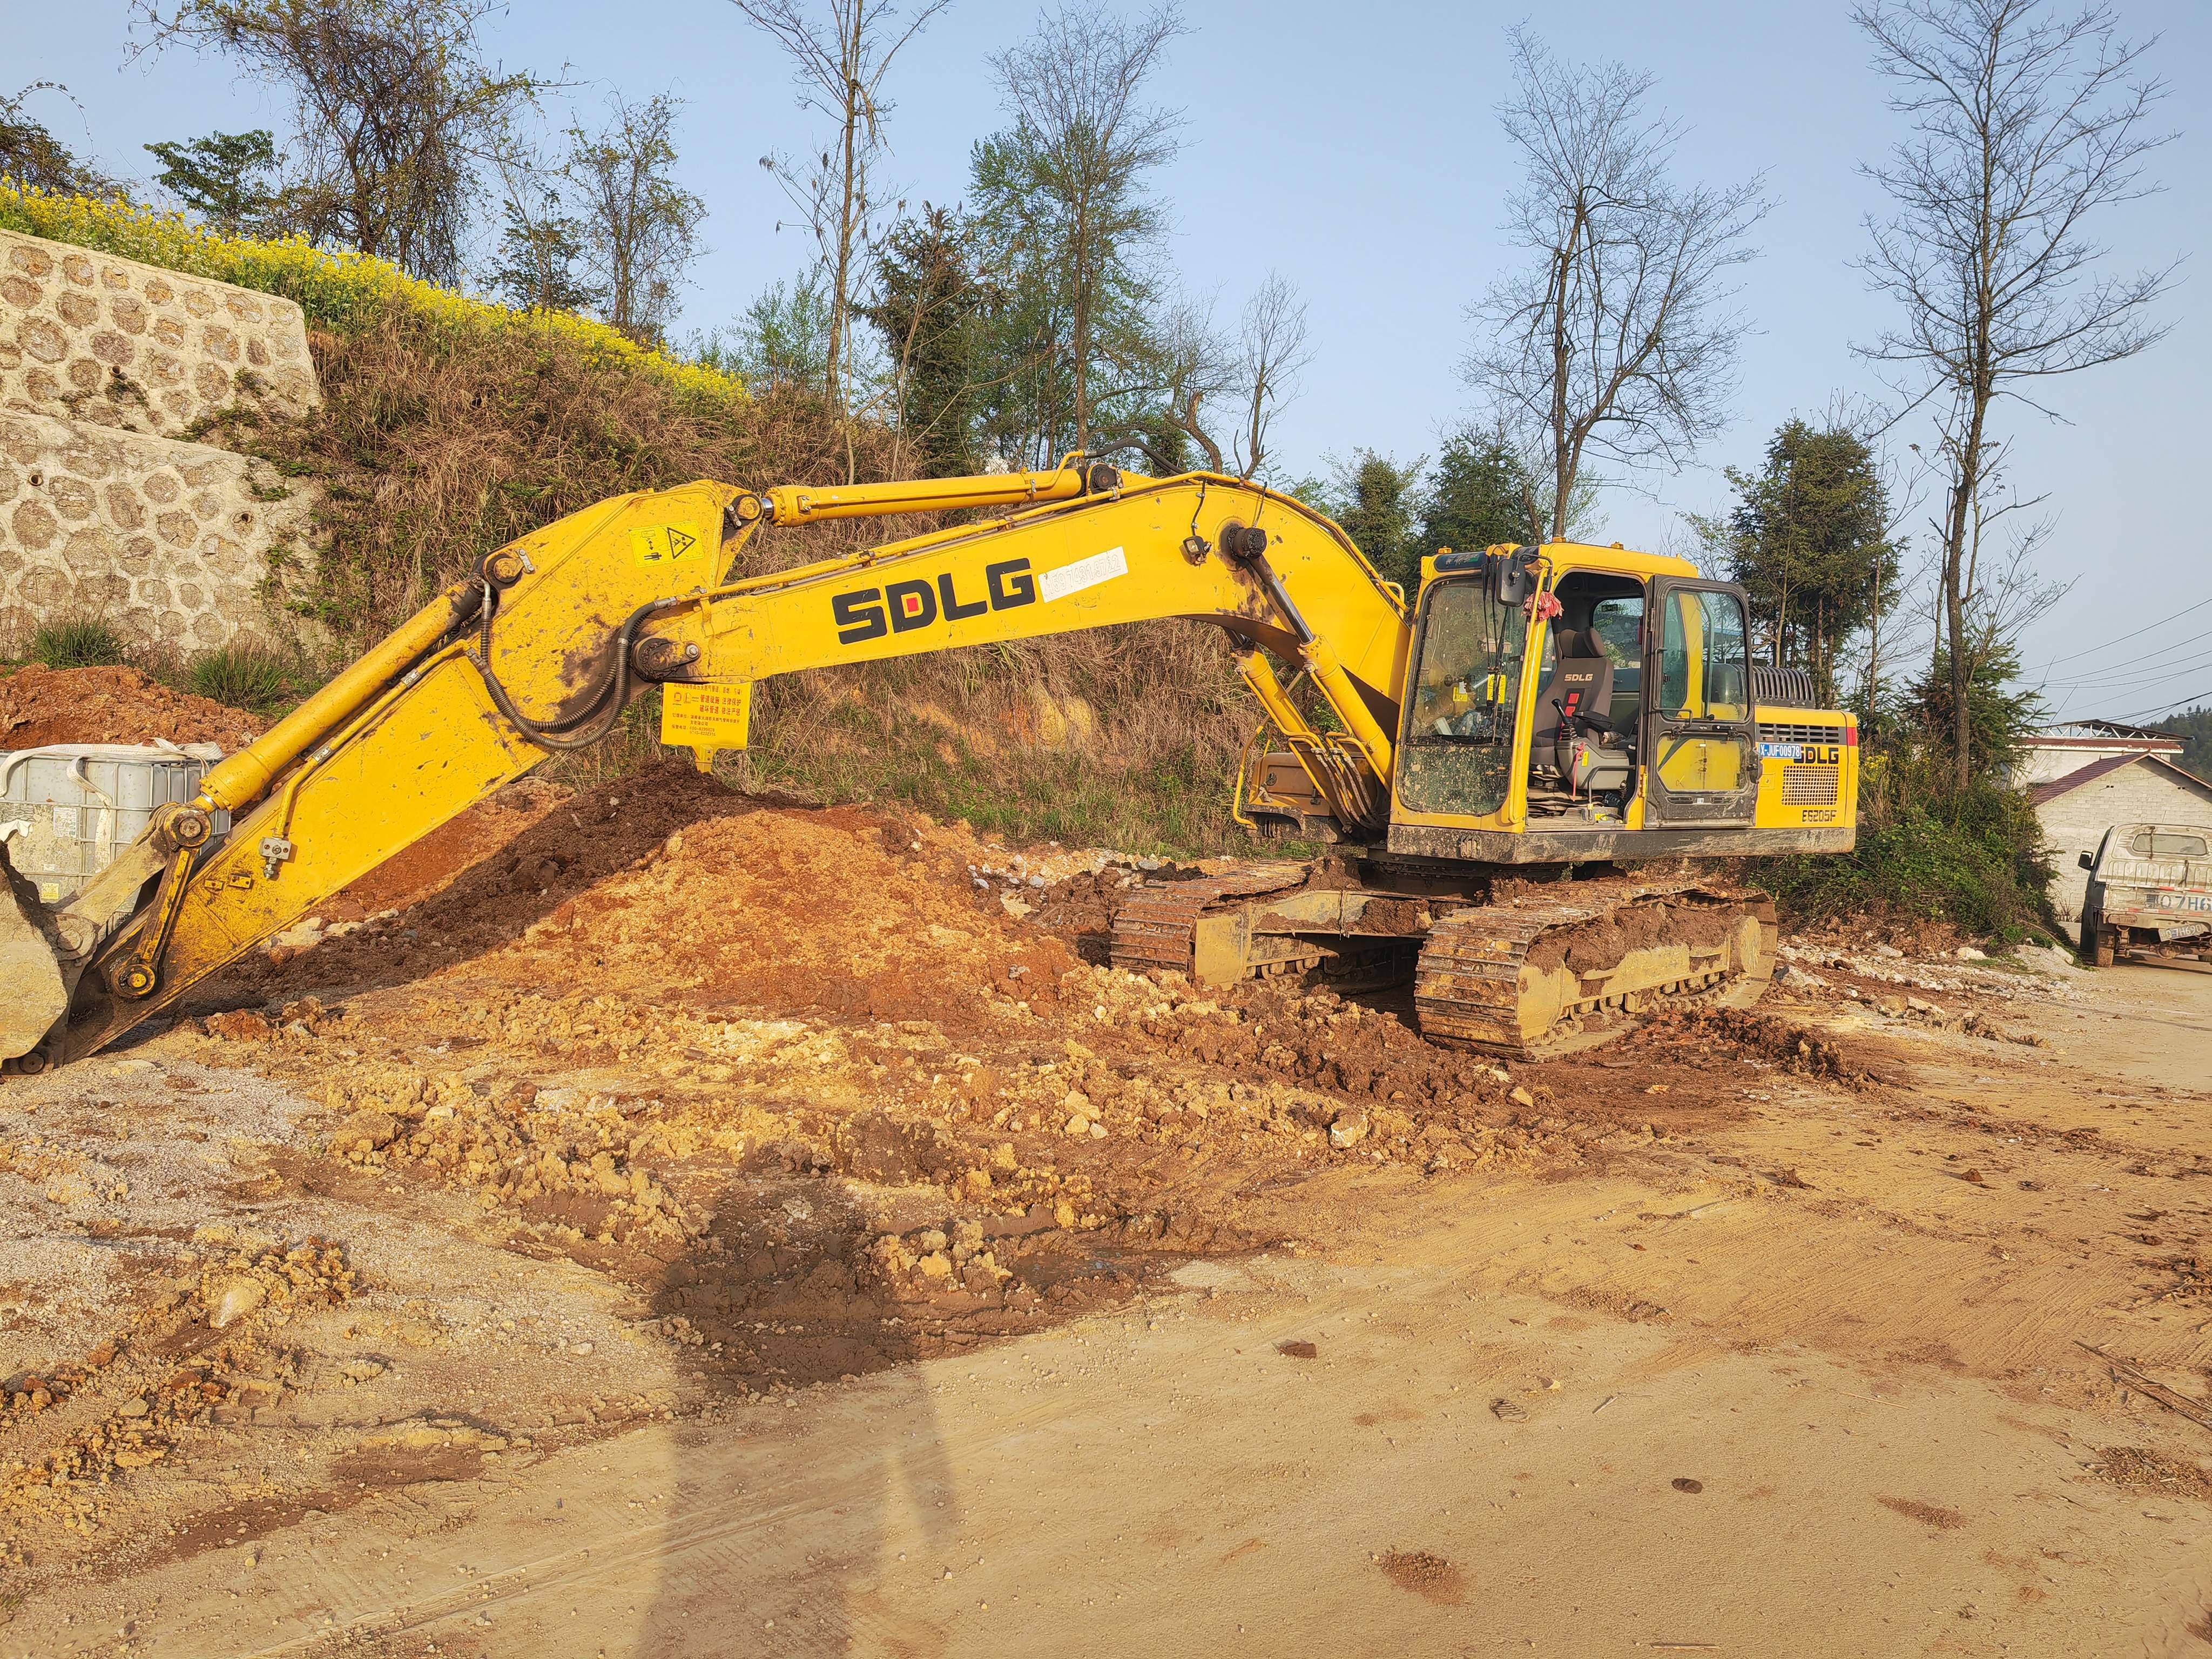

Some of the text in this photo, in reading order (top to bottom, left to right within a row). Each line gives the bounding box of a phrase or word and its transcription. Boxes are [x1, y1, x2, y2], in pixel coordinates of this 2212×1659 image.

[832, 557, 1036, 645] SDLG
[1564, 673, 1594, 682] SDLG
[1760, 744, 1800, 757] X-JUF00978
